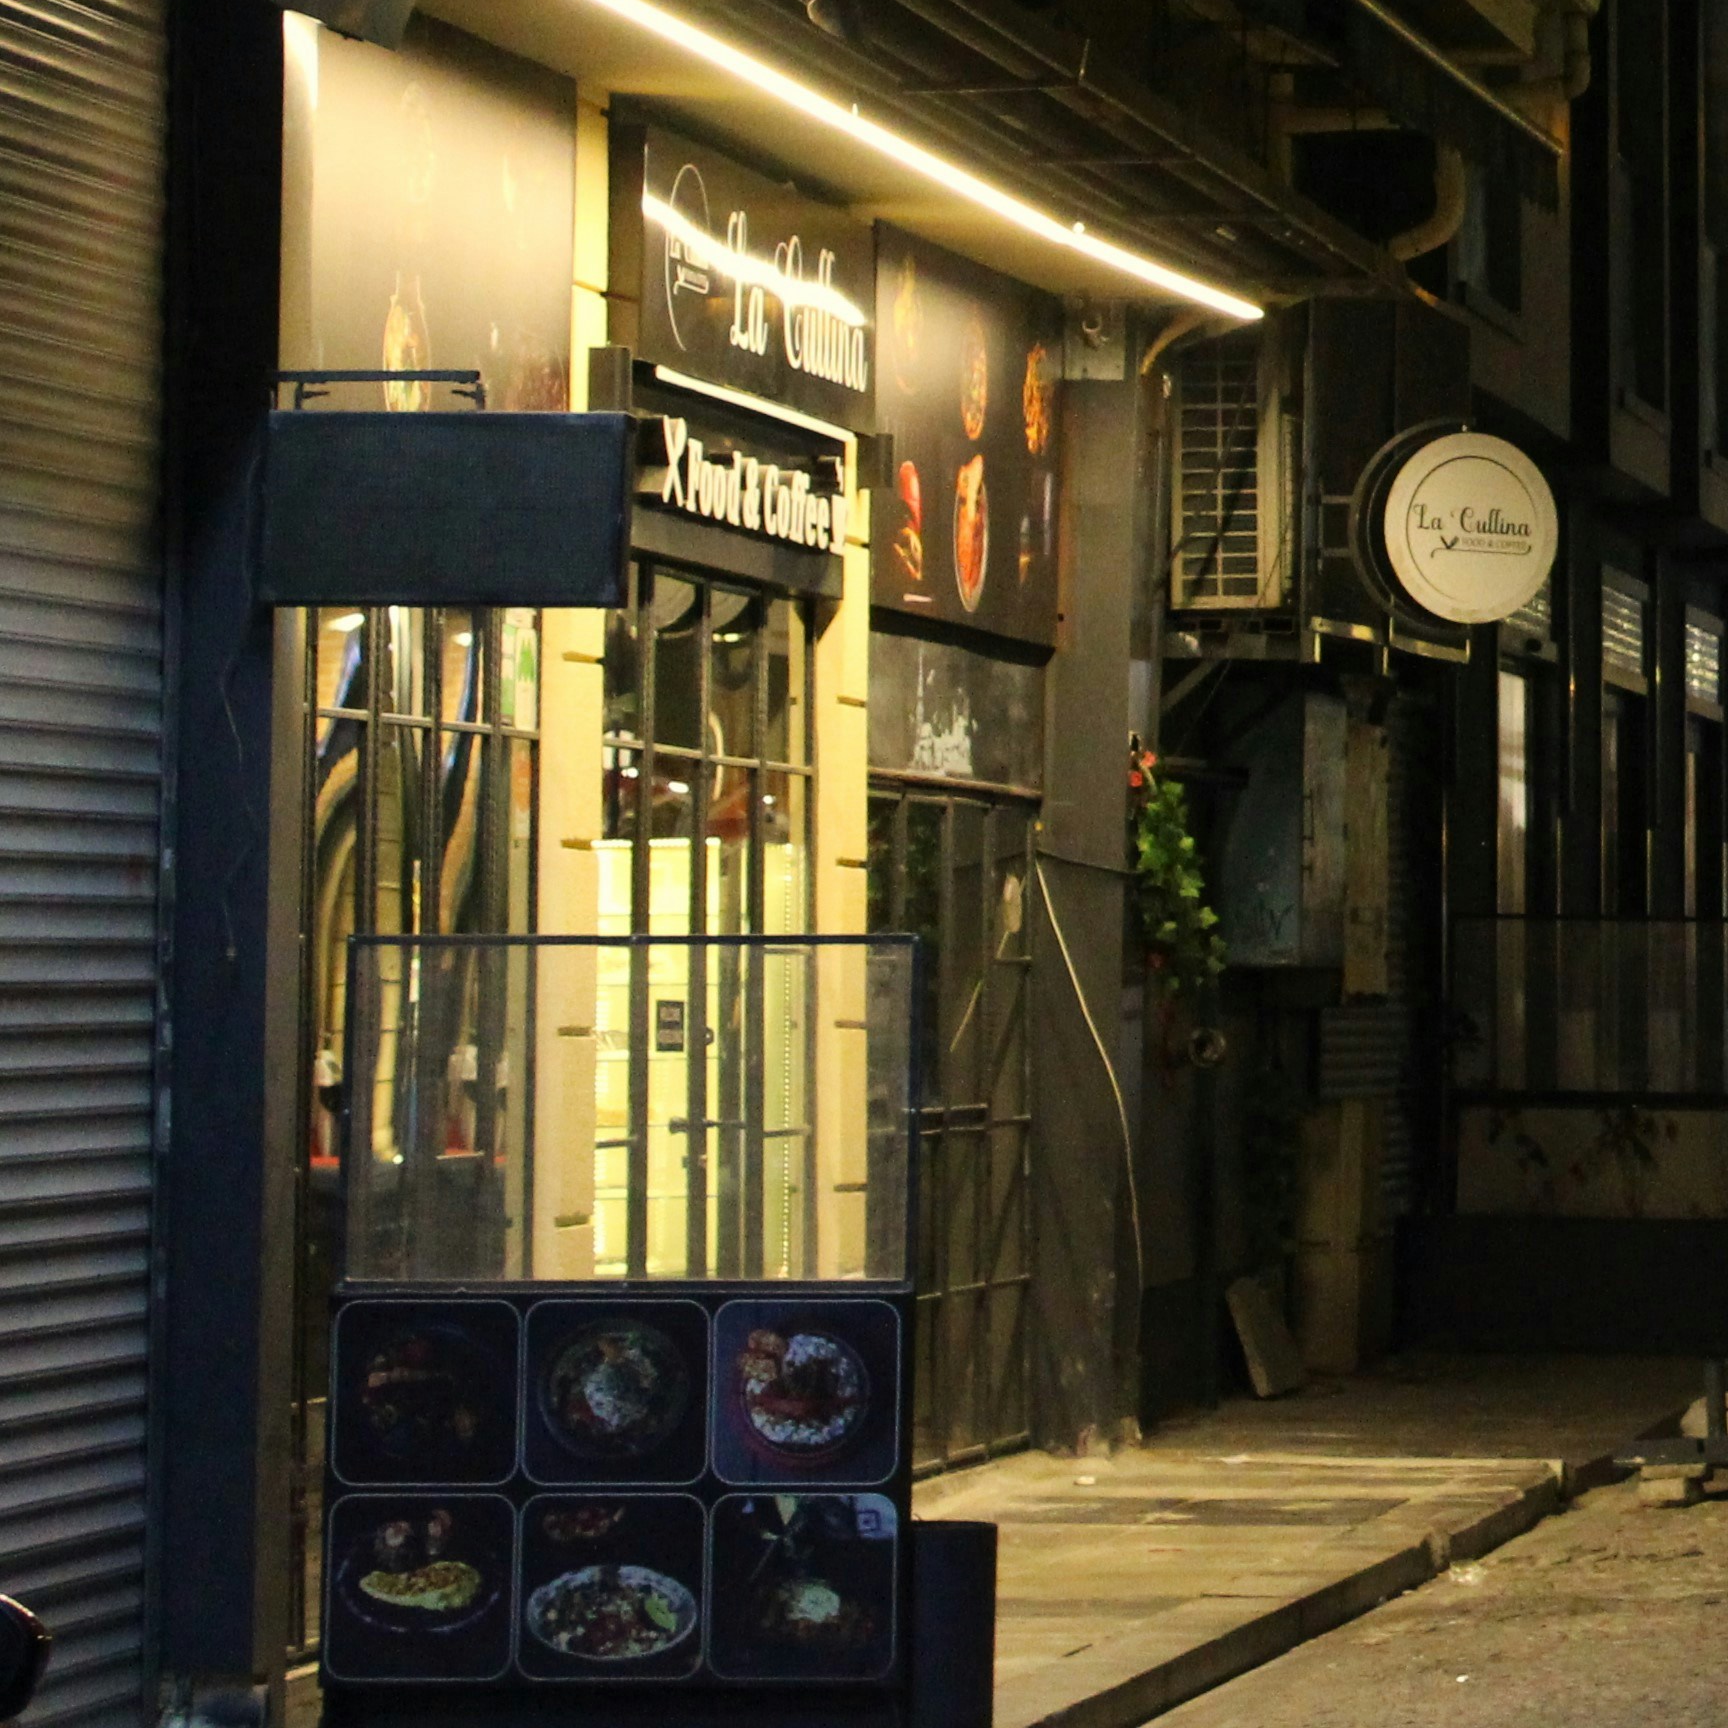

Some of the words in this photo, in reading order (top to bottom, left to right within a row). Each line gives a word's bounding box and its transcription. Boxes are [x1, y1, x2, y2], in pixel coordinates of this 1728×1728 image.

[686, 438, 742, 528] Food
[743, 456, 761, 531] &
[762, 463, 830, 551] Coffee
[1412, 503, 1443, 531] La
[1451, 506, 1533, 537] Cullina
